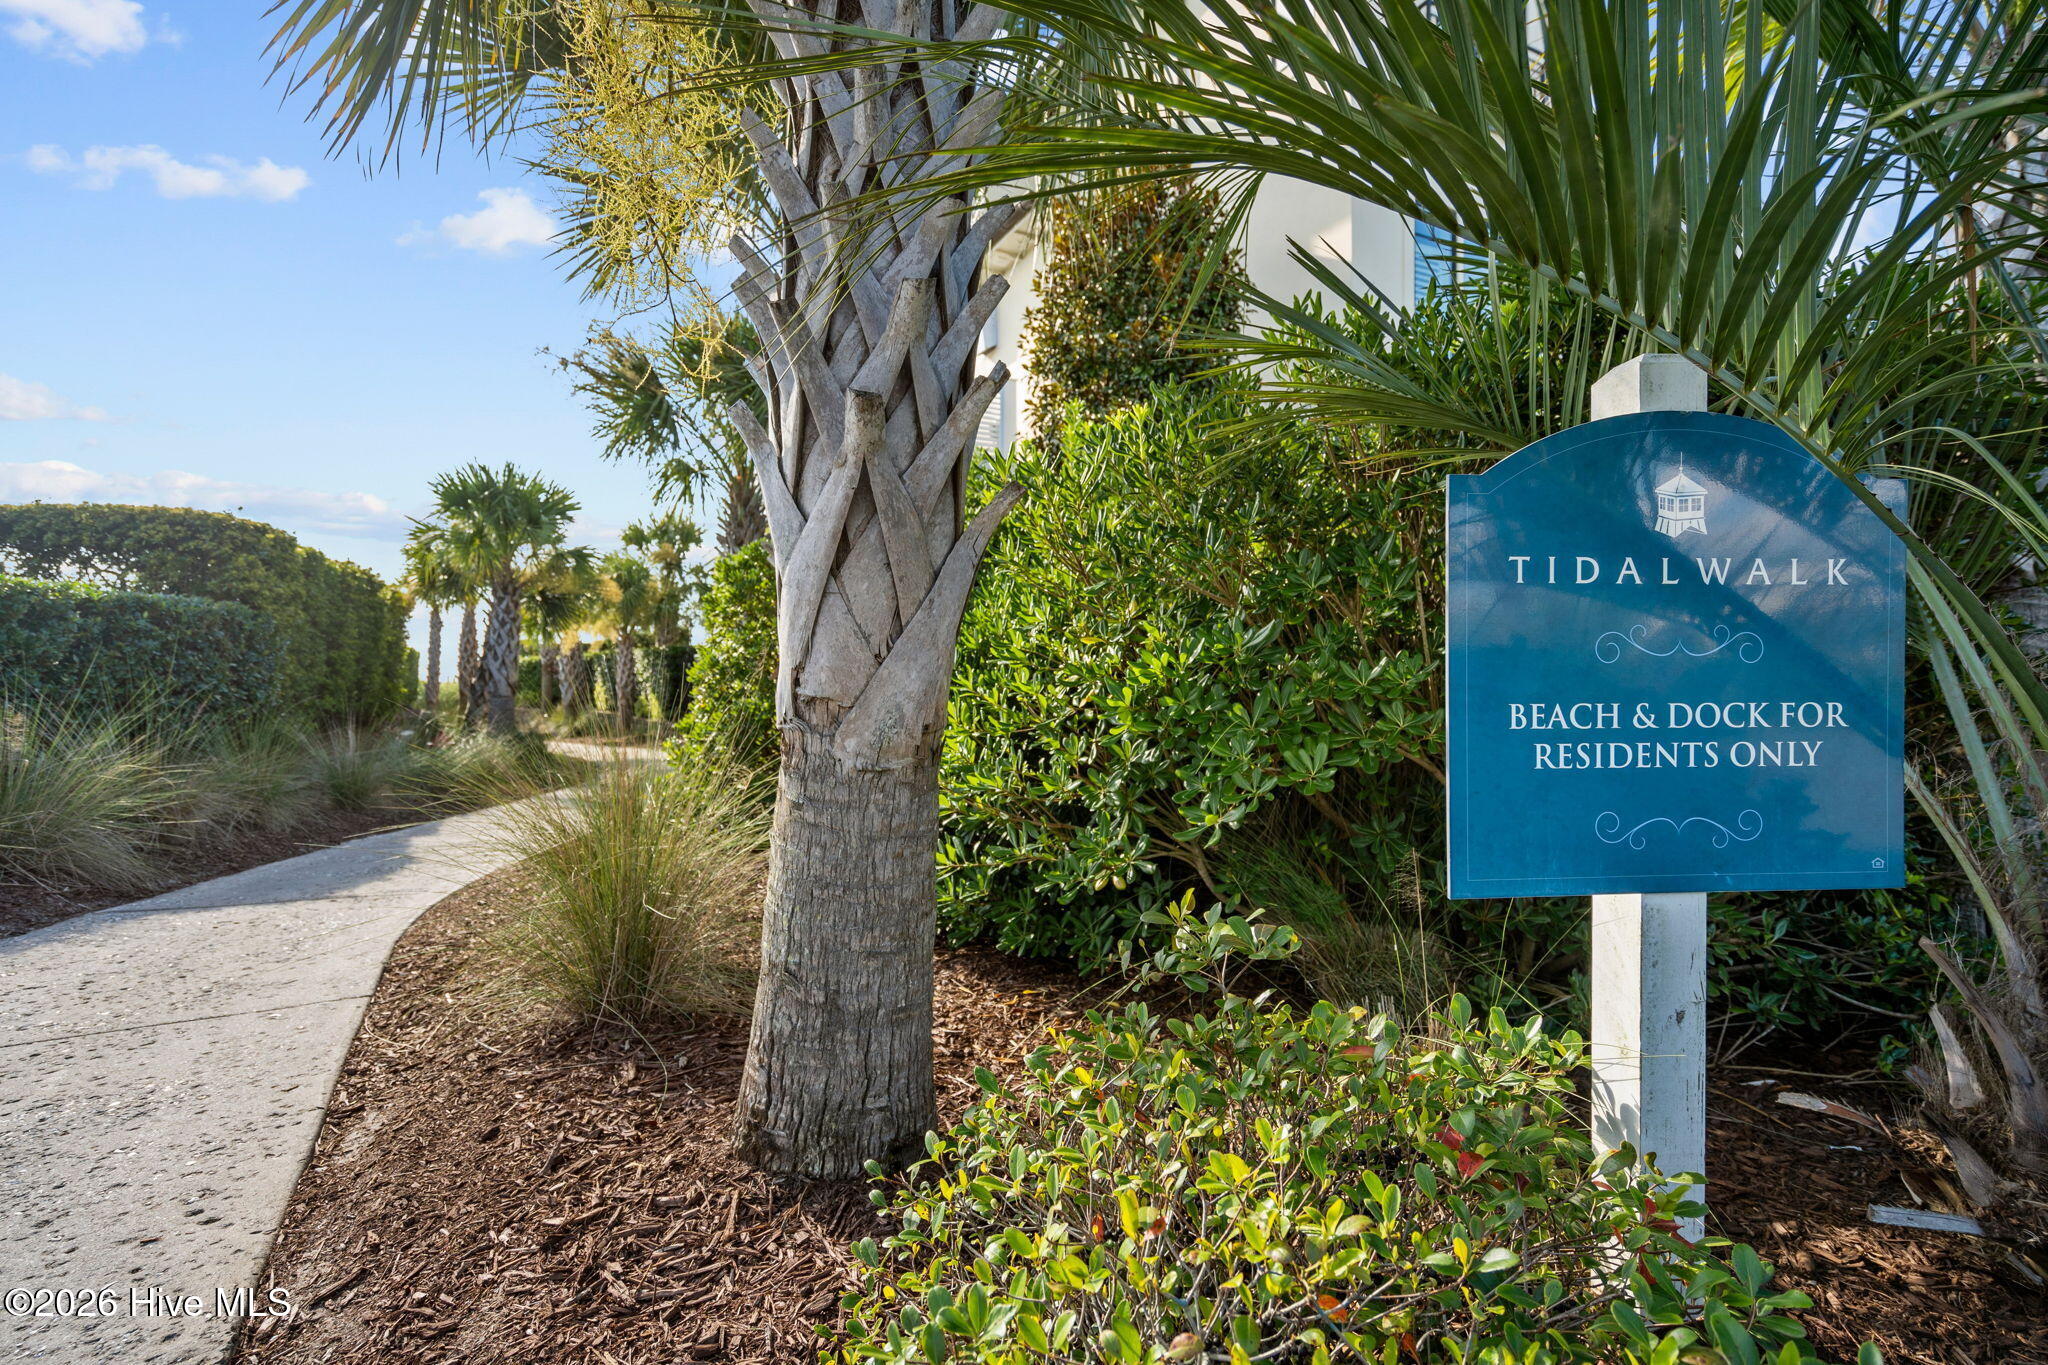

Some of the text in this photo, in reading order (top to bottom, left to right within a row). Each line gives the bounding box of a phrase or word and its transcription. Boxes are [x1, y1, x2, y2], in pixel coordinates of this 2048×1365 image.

[1508, 556, 1850, 586] TIDALWALK
[1508, 701, 1850, 730] BEACH & DOCK FOR
[1533, 740, 1824, 770] RESIDENTS ONLY
